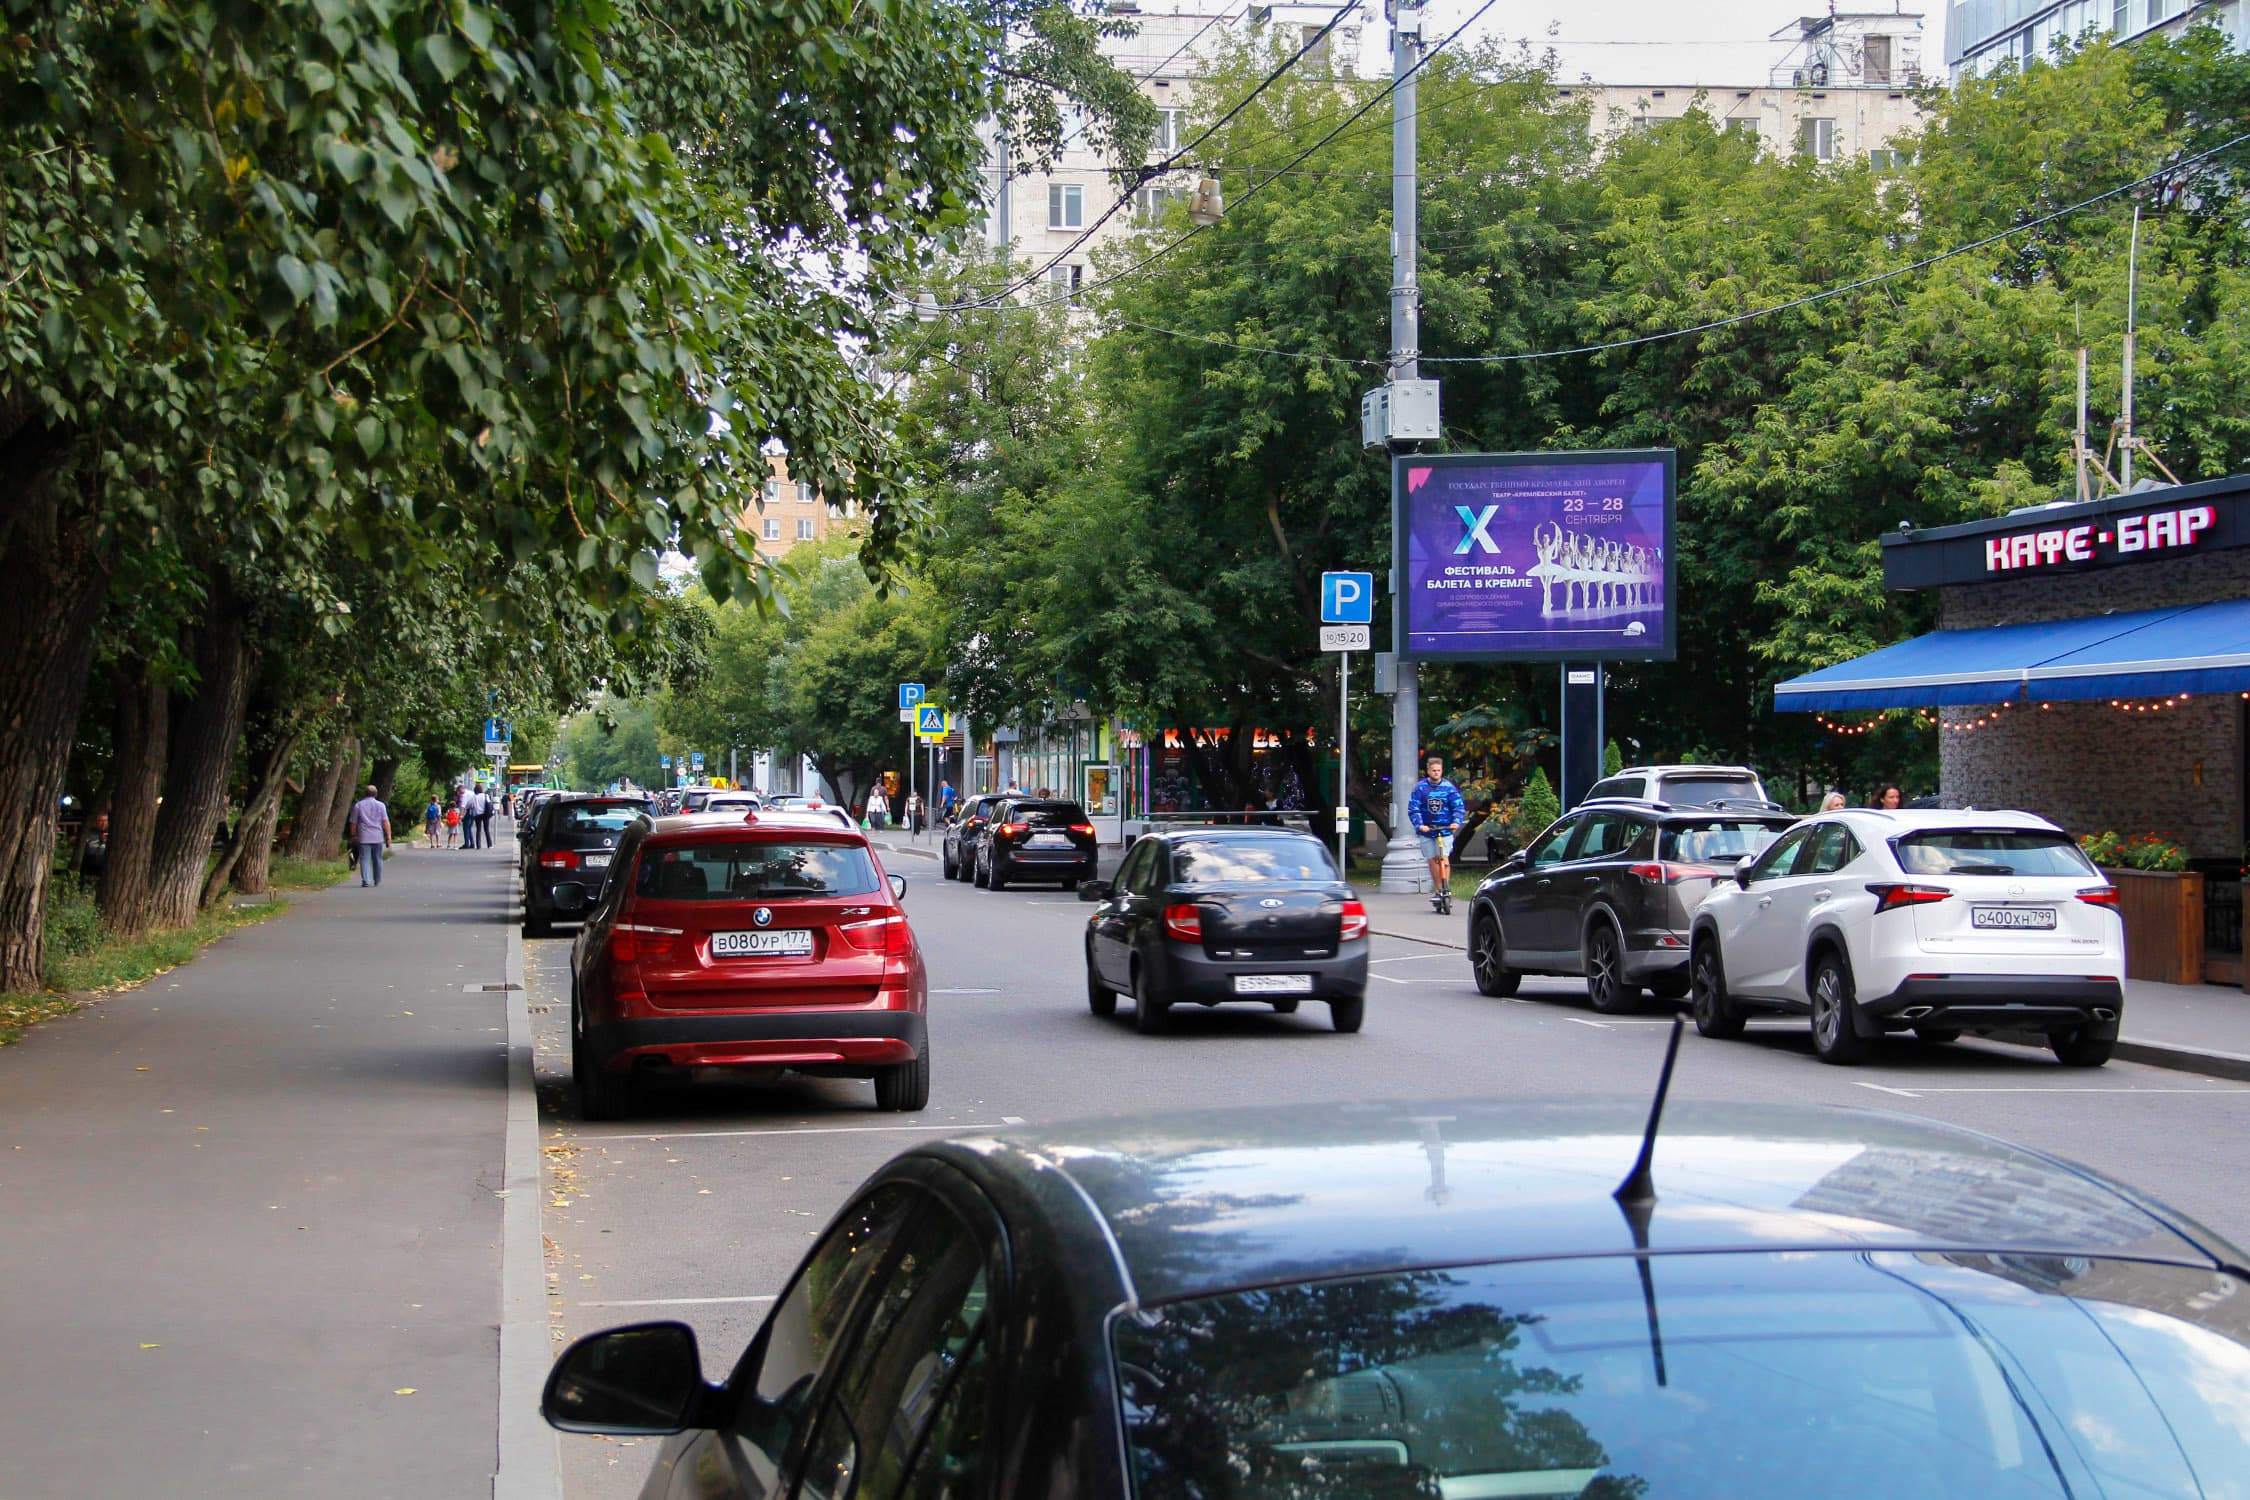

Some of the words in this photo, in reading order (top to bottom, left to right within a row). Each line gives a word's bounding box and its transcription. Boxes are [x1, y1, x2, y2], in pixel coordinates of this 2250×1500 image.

[1563, 499, 1584, 512] 23
[1602, 498, 1623, 511] 28
[1565, 514, 1622, 525] СЕНТЯБРЯ
[1453, 505, 1502, 554] X
[1444, 566, 1516, 576] ФЕСТИВАЛЬ
[1427, 580, 1472, 589] БАЛЕТА
[1475, 579, 1483, 588] В
[1485, 578, 1533, 588] КРЕМЛЕ
[1336, 579, 1360, 615] P
[1337, 633, 1346, 641] 15
[1350, 632, 1364, 643] 20
[906, 687, 919, 705] P
[1978, 911, 2030, 925] О400ХН
[2032, 911, 2051, 922] 799
[718, 934, 780, 950] В080УР
[784, 931, 805, 944] 177
